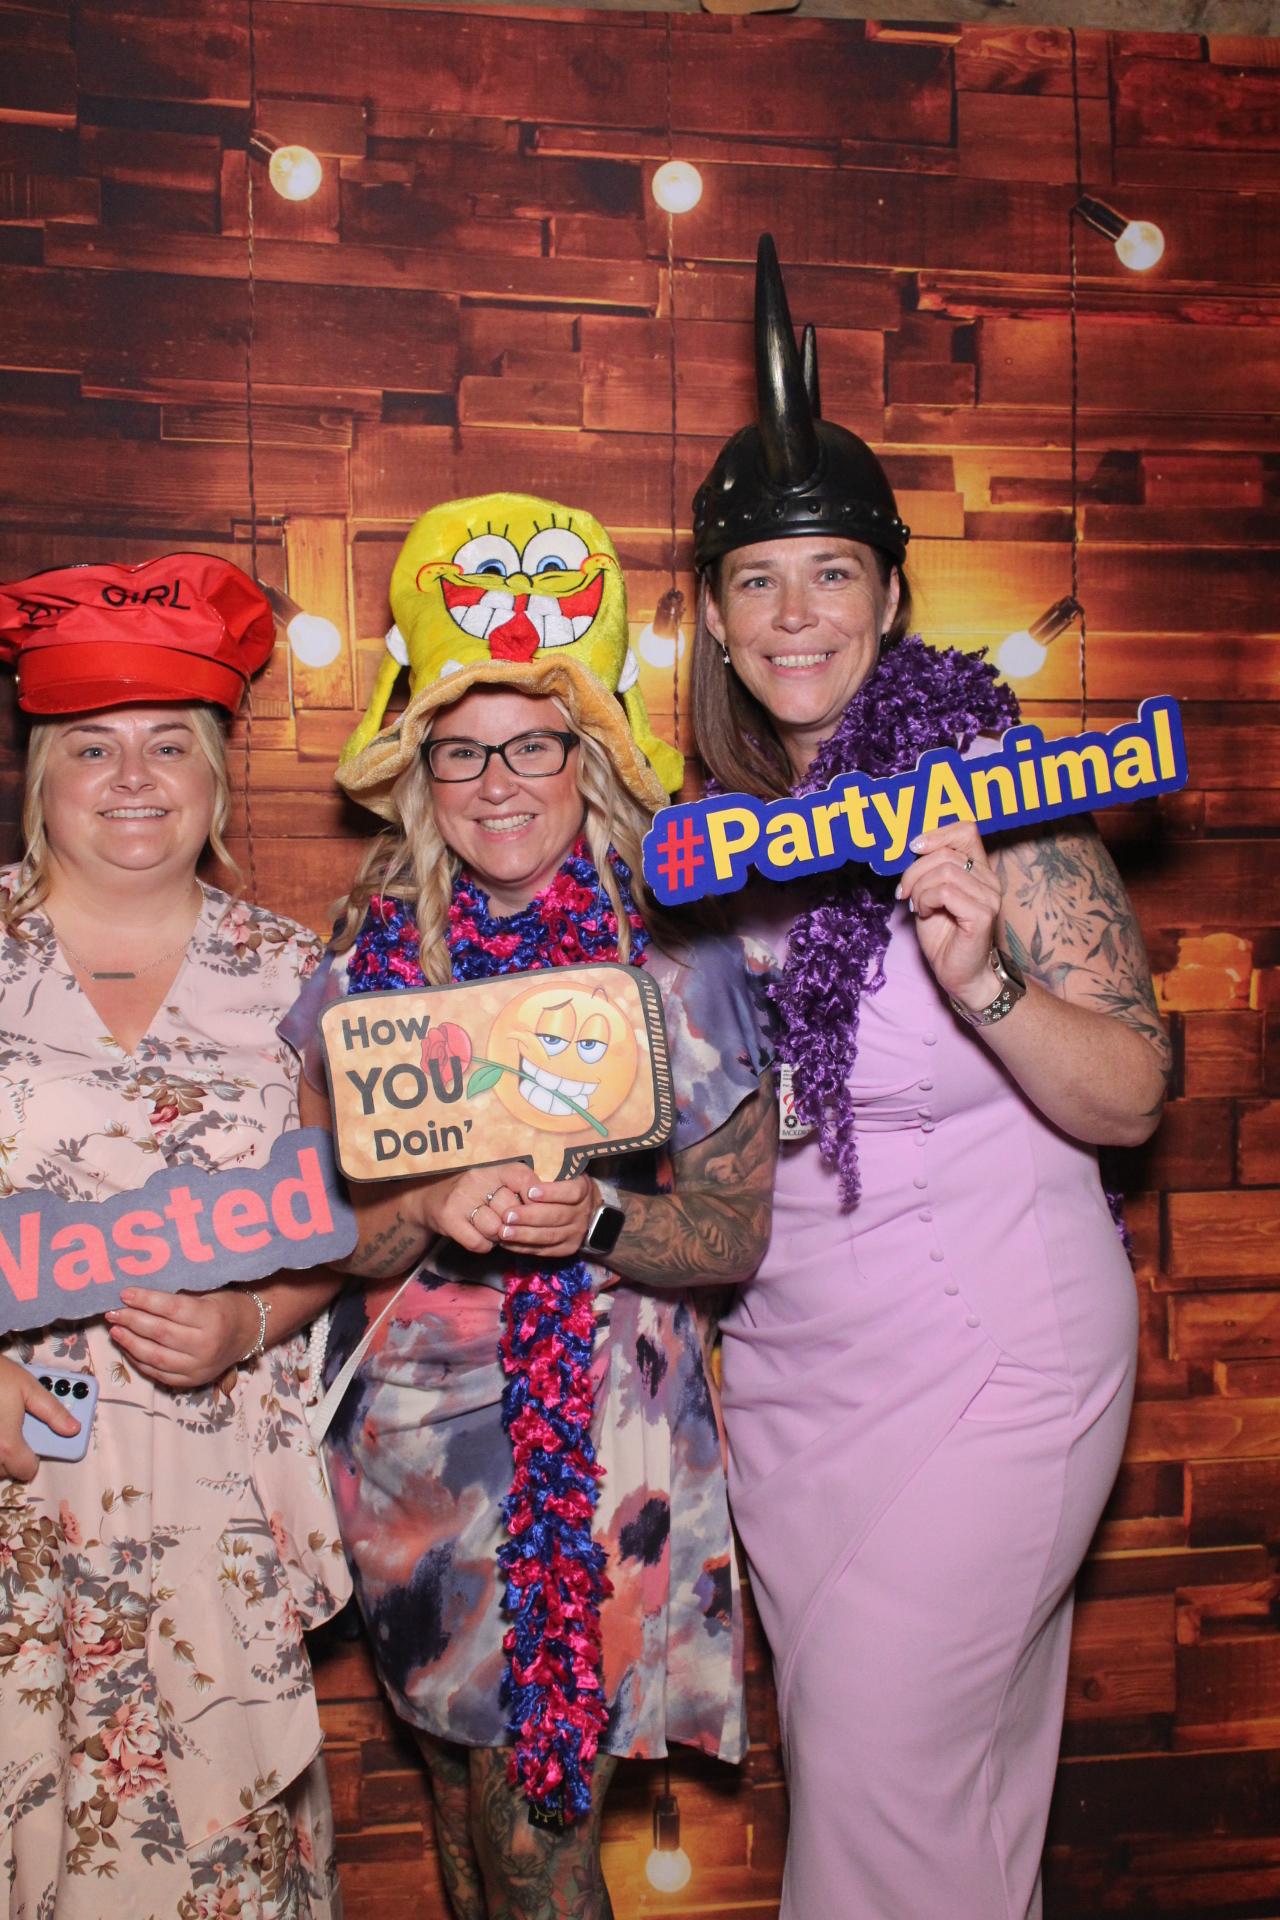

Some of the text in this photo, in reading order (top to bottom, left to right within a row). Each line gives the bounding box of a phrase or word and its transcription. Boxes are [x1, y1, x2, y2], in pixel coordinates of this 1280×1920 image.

[656, 708, 1178, 892] #PartyAnimal
[341, 1014, 431, 1051] How
[345, 1055, 465, 1116] YOU
